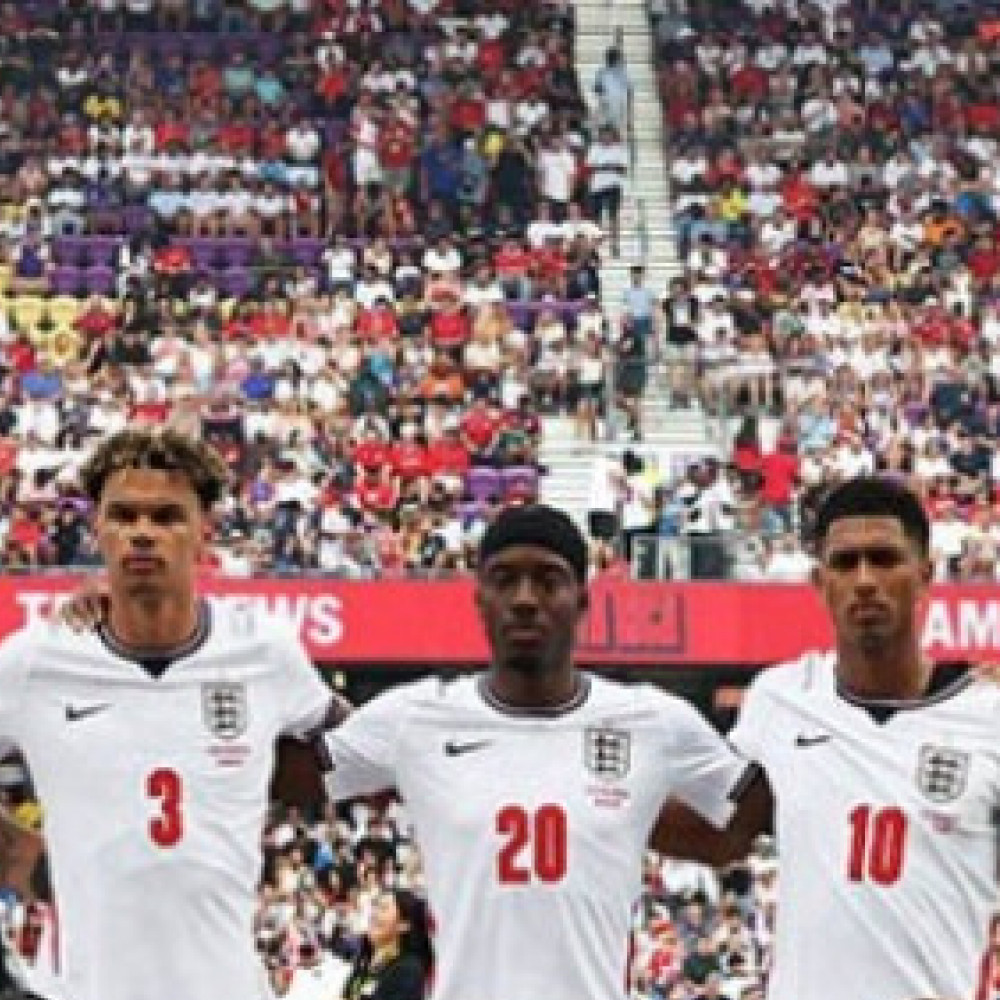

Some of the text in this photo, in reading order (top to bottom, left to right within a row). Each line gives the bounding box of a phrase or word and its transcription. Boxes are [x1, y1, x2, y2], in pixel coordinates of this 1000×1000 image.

[145, 766, 185, 850] 3
[496, 803, 569, 887] 20
[847, 805, 908, 888] 10
